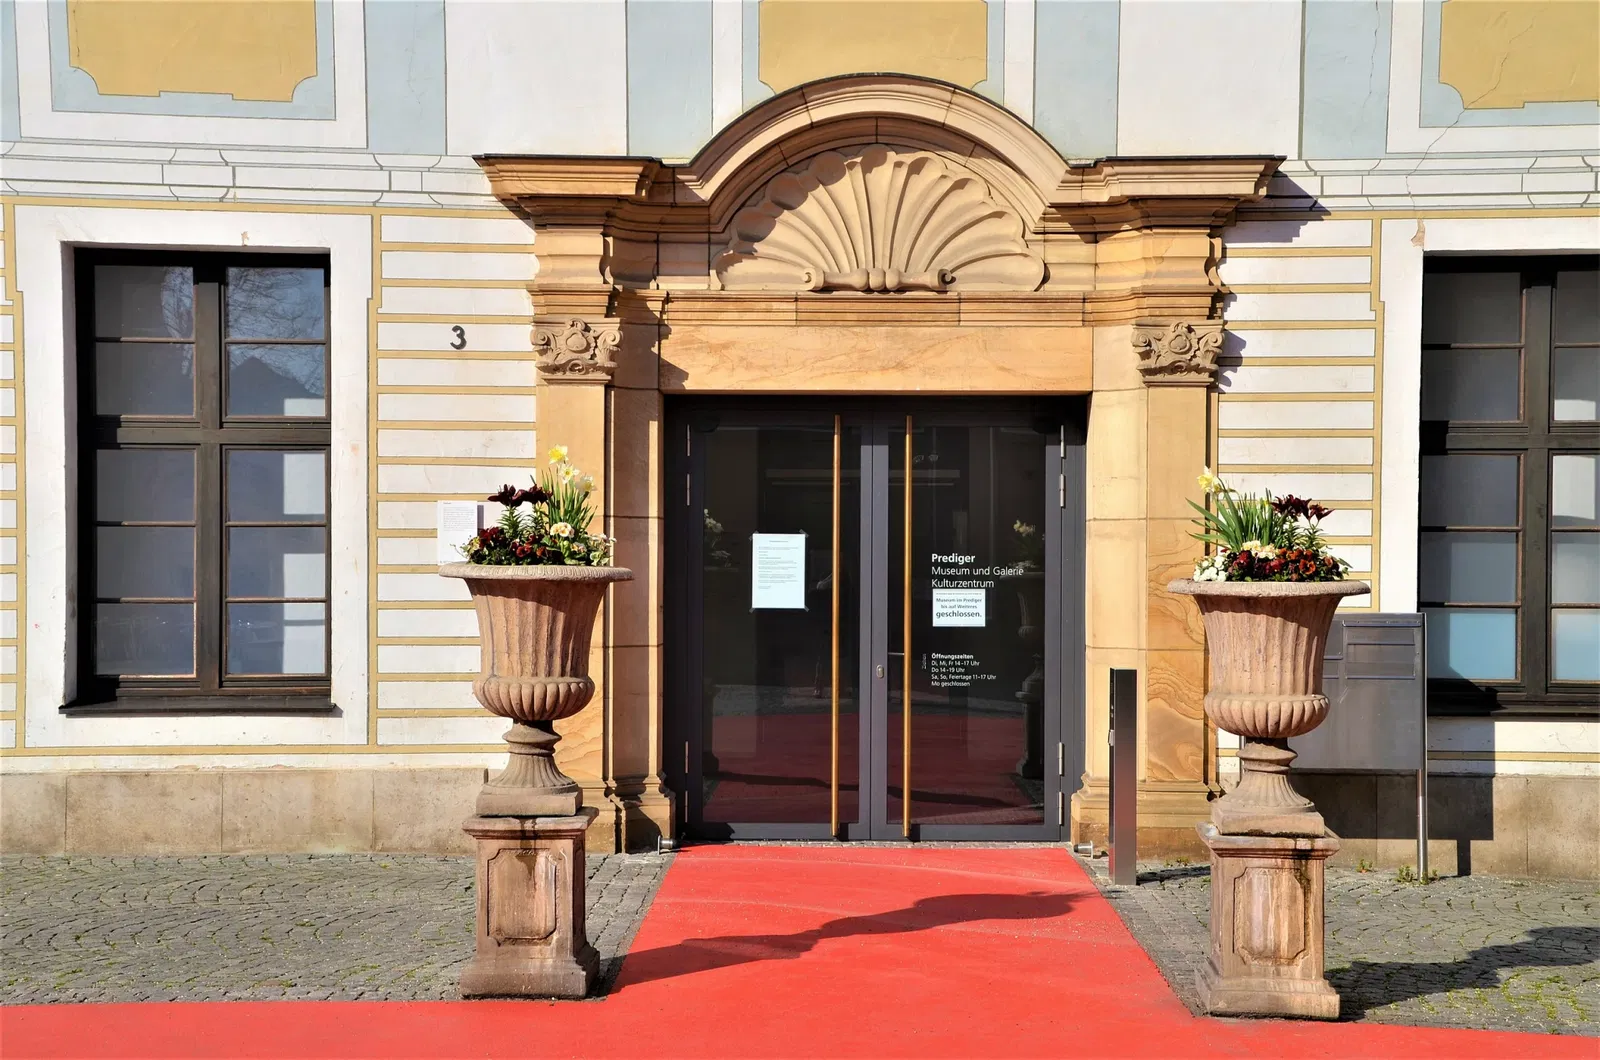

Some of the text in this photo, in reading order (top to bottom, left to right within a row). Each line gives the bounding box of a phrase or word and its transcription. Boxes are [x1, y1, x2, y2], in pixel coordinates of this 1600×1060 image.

[449, 324, 467, 350] 3
[931, 553, 976, 565] Prediger
[931, 566, 1024, 576] Museum und Galerie
[931, 579, 995, 588] Kulturzentrum
[935, 610, 983, 619] geschlossen.
[931, 652, 974, 660] Öffnungszeiten
